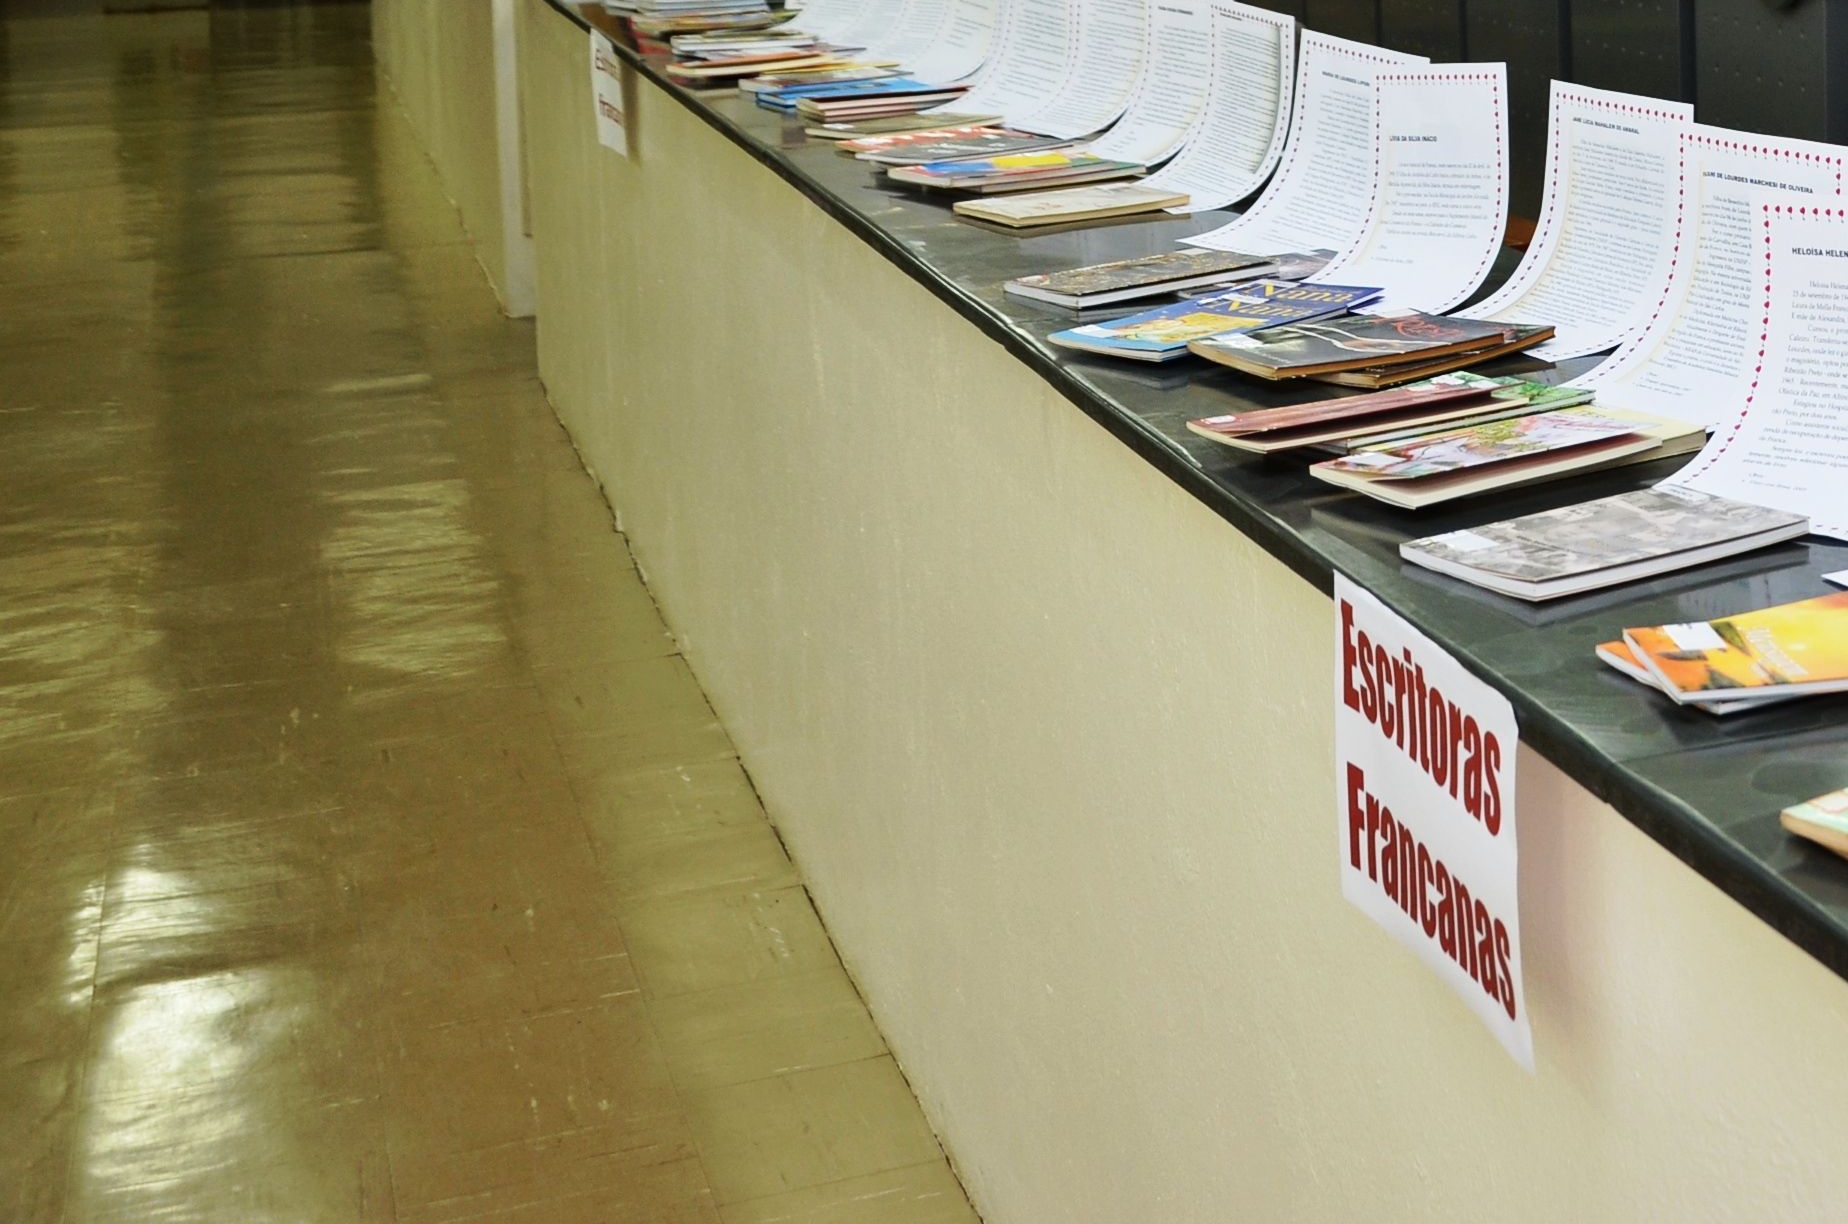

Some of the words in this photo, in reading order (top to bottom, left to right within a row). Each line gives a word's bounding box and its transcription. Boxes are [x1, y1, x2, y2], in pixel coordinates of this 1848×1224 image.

[1724, 174, 1749, 183] LOURDES
[1787, 184, 1814, 194] OLIVEIRA
[1791, 247, 1823, 256] HELOÍSA
[1341, 598, 1501, 837] Escritoras
[1347, 761, 1517, 1023] Francanas
